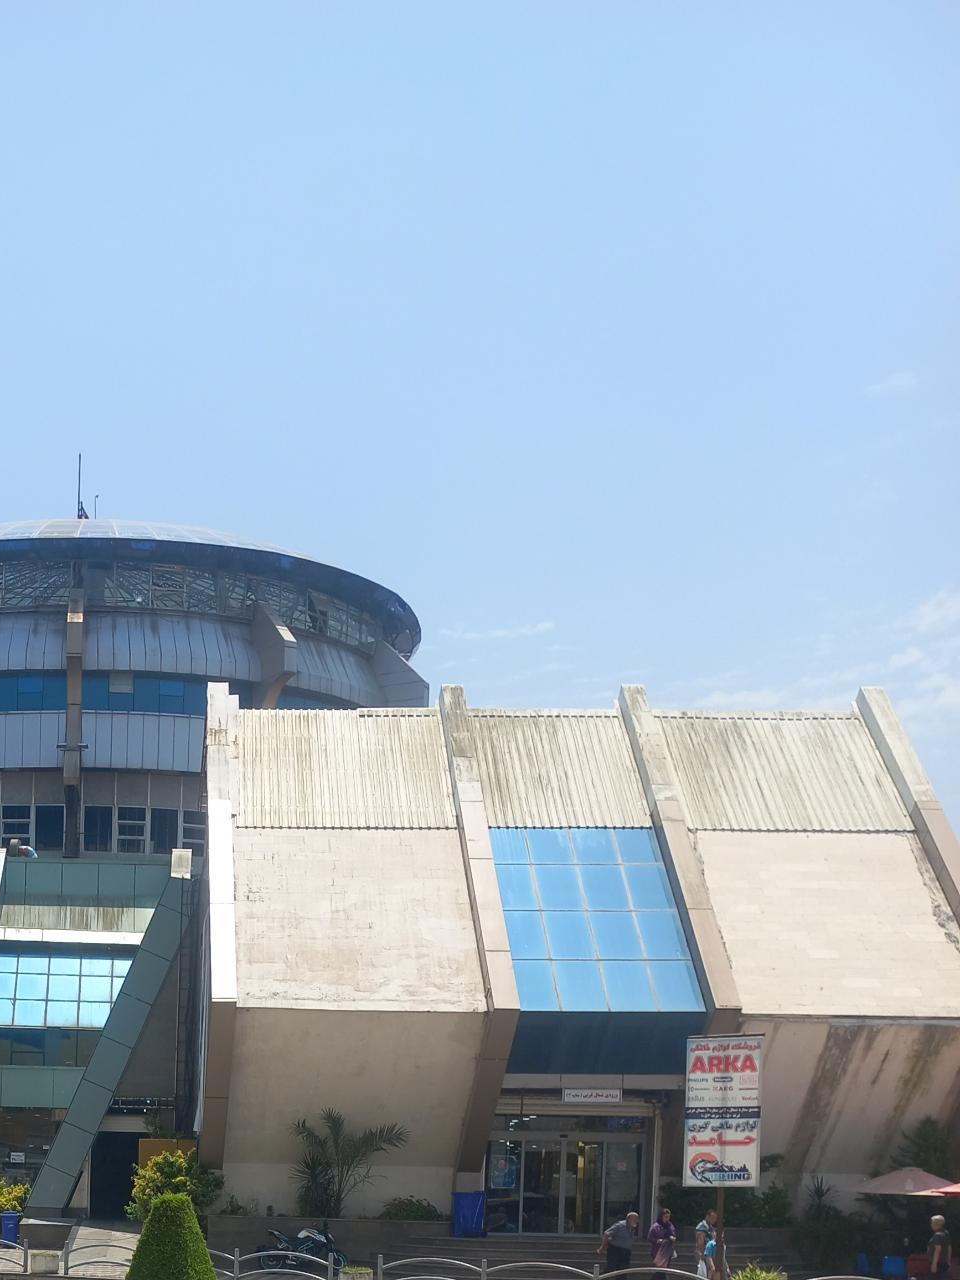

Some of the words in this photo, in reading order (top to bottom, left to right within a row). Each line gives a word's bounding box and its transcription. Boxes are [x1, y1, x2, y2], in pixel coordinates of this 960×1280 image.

[712, 1043, 730, 1053] لوازم
[731, 1041, 762, 1052] فروشگاه
[690, 1054, 758, 1073] ARKA
[688, 1120, 711, 1132] گیری
[711, 1120, 733, 1132] ماهی
[735, 1120, 758, 1132] لوازم
[688, 1132, 757, 1147] حامد
